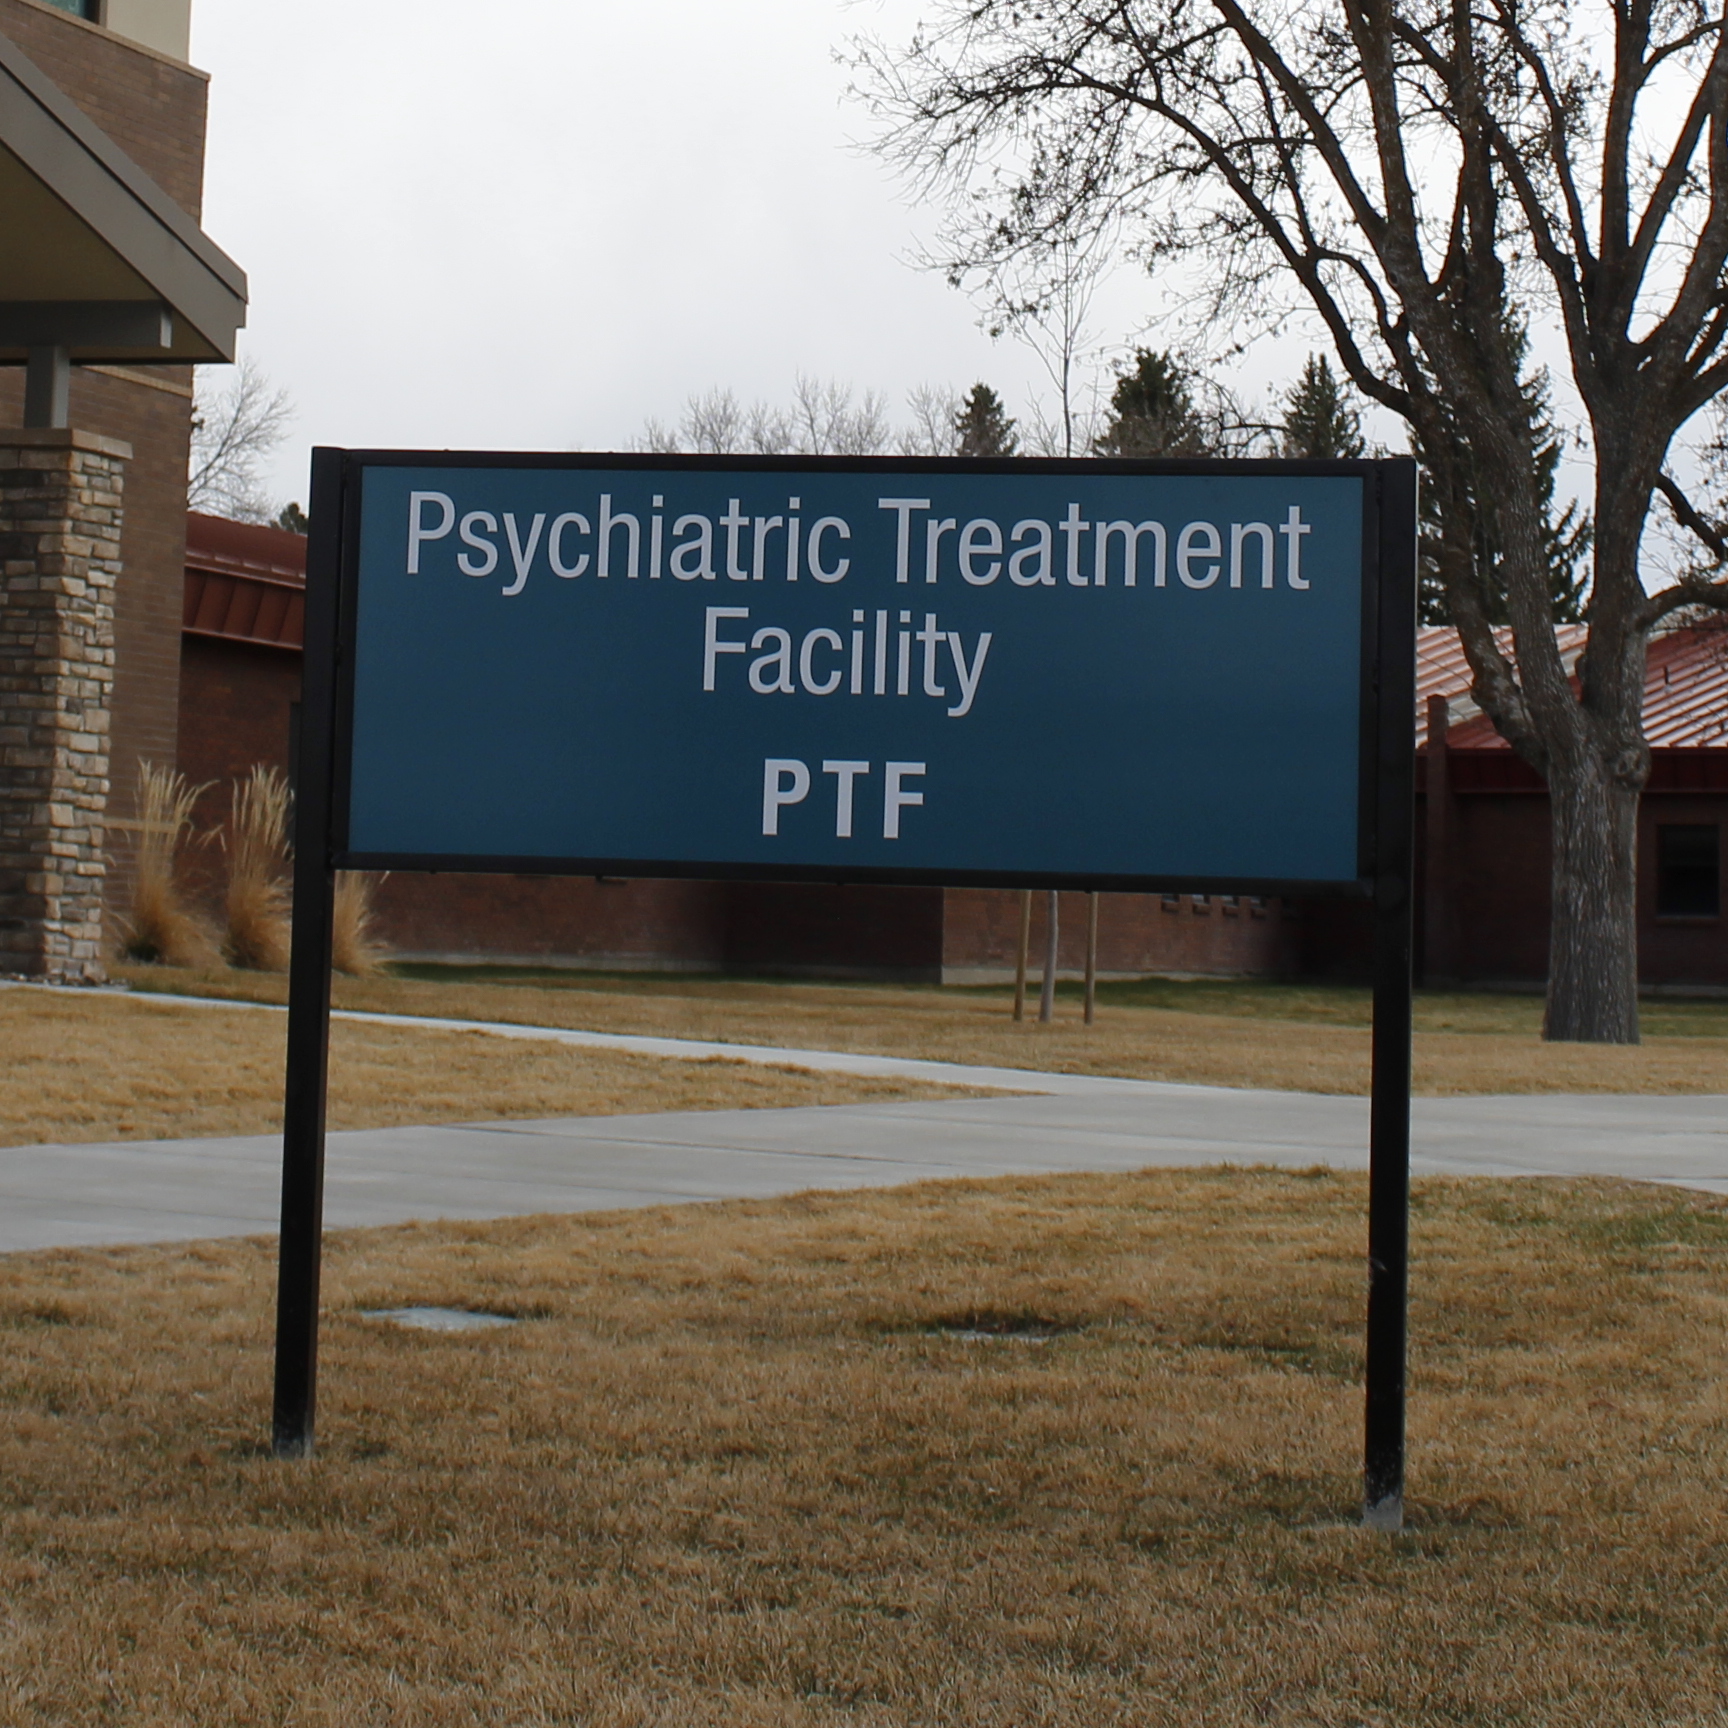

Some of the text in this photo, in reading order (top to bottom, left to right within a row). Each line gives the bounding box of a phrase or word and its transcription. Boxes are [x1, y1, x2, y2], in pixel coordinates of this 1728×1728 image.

[406, 490, 1312, 597] Psychiatric Treatment
[702, 606, 993, 718] Facility
[761, 758, 927, 840] PTF
